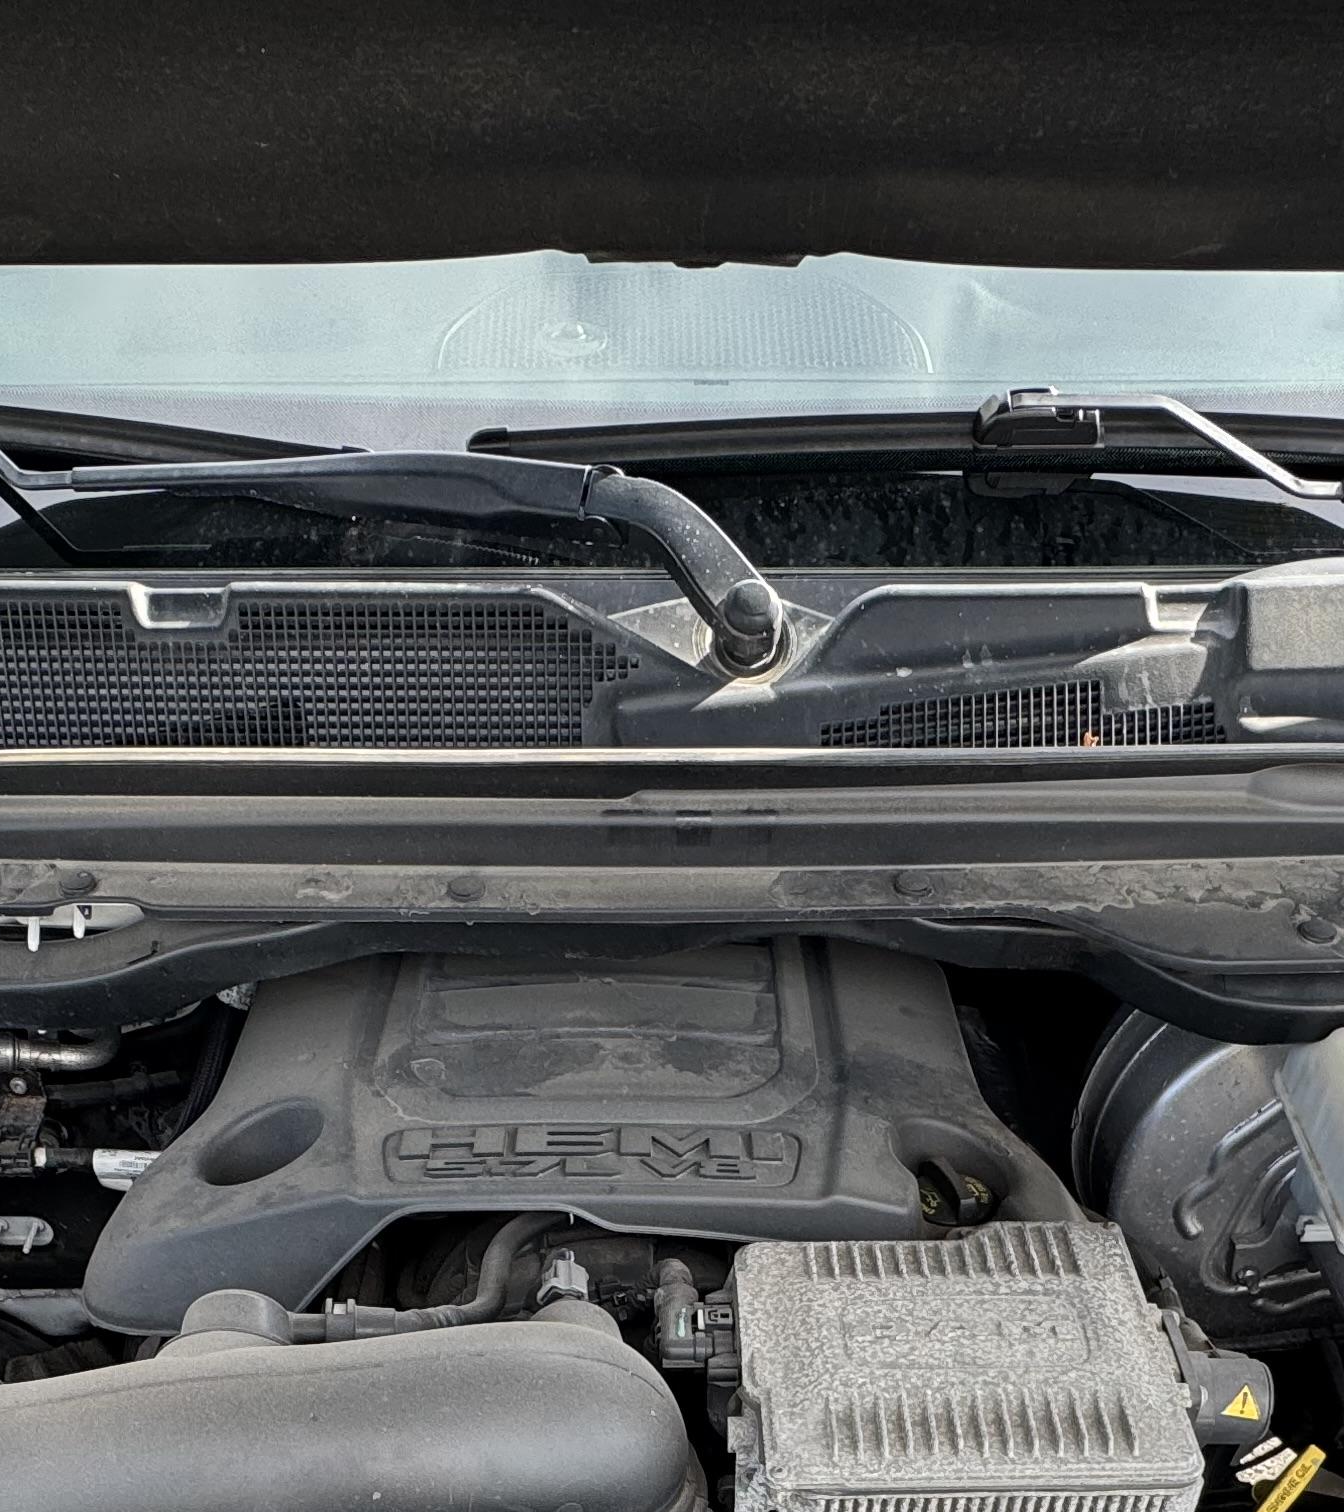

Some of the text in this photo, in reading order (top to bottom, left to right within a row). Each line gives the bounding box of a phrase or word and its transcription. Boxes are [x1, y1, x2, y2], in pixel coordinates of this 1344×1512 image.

[398, 1126, 784, 1163] HEMI
[423, 1157, 758, 1180] 5.7L V8
